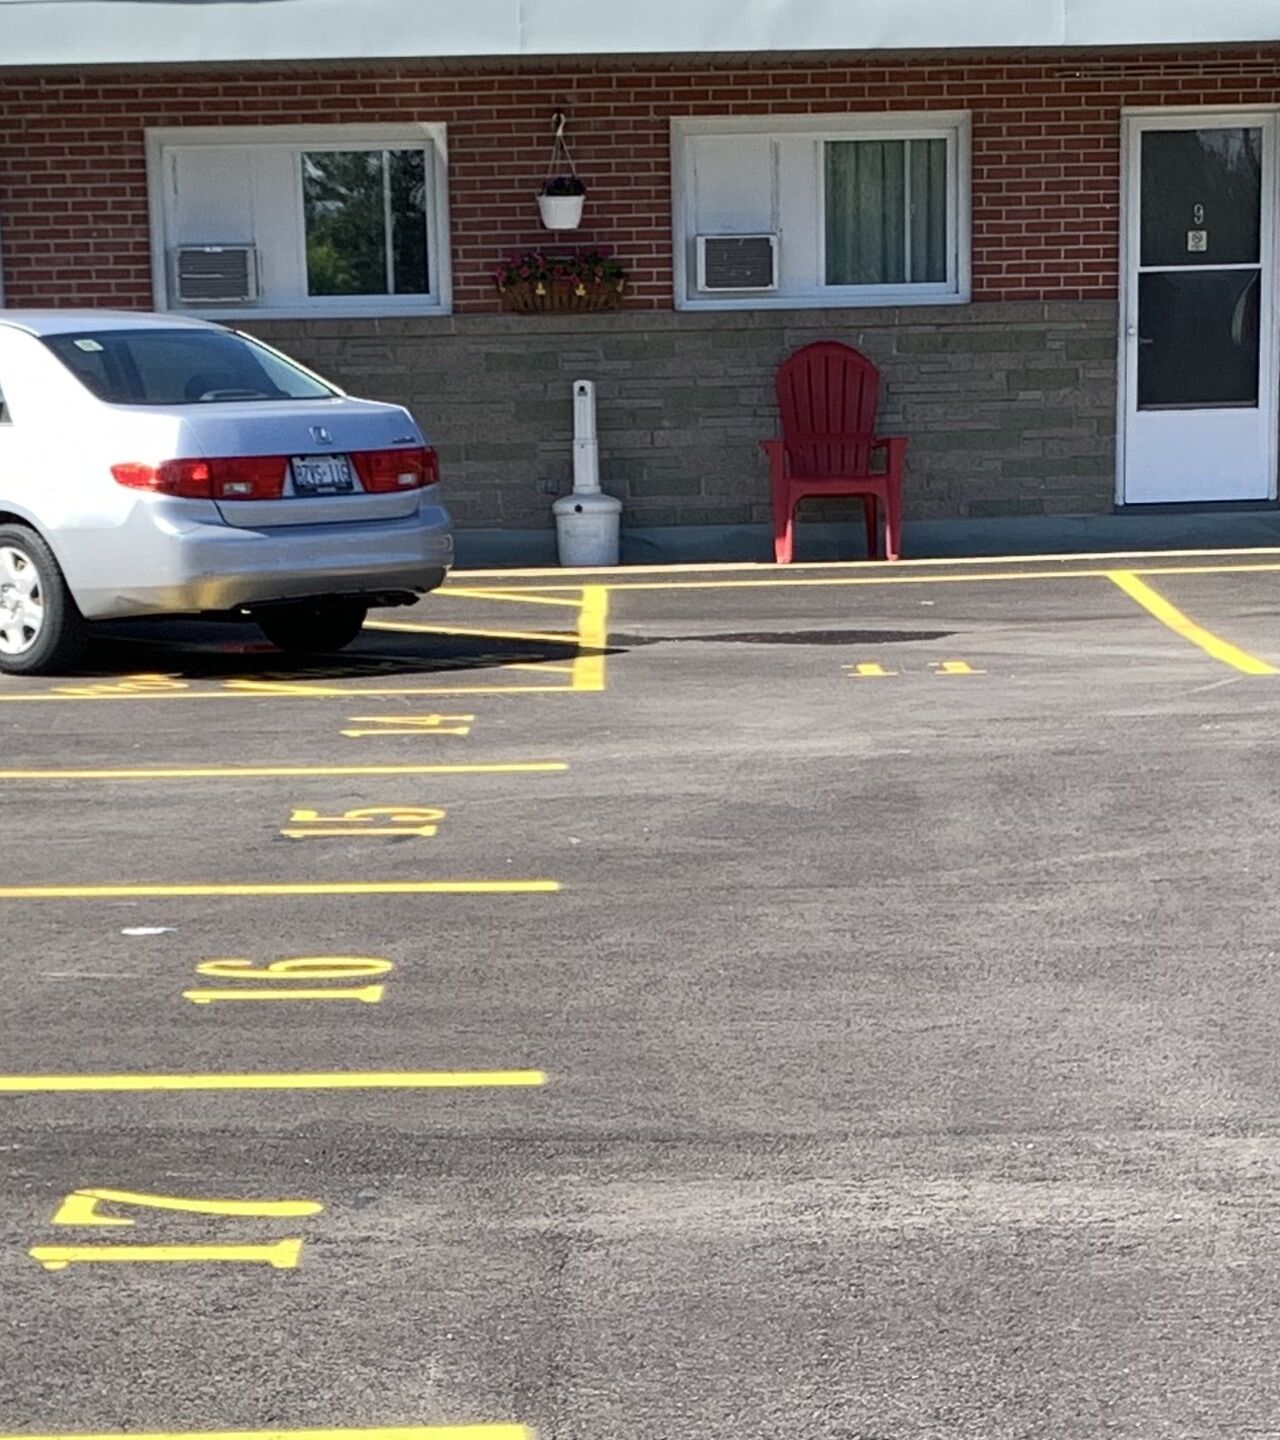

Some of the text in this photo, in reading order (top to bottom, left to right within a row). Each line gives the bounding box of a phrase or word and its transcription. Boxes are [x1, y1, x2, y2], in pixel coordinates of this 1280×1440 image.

[1194, 203, 1204, 225] 9
[339, 713, 476, 738] 14
[280, 806, 447, 837] 15
[181, 956, 395, 1004] 16
[28, 1187, 324, 1269] 17
